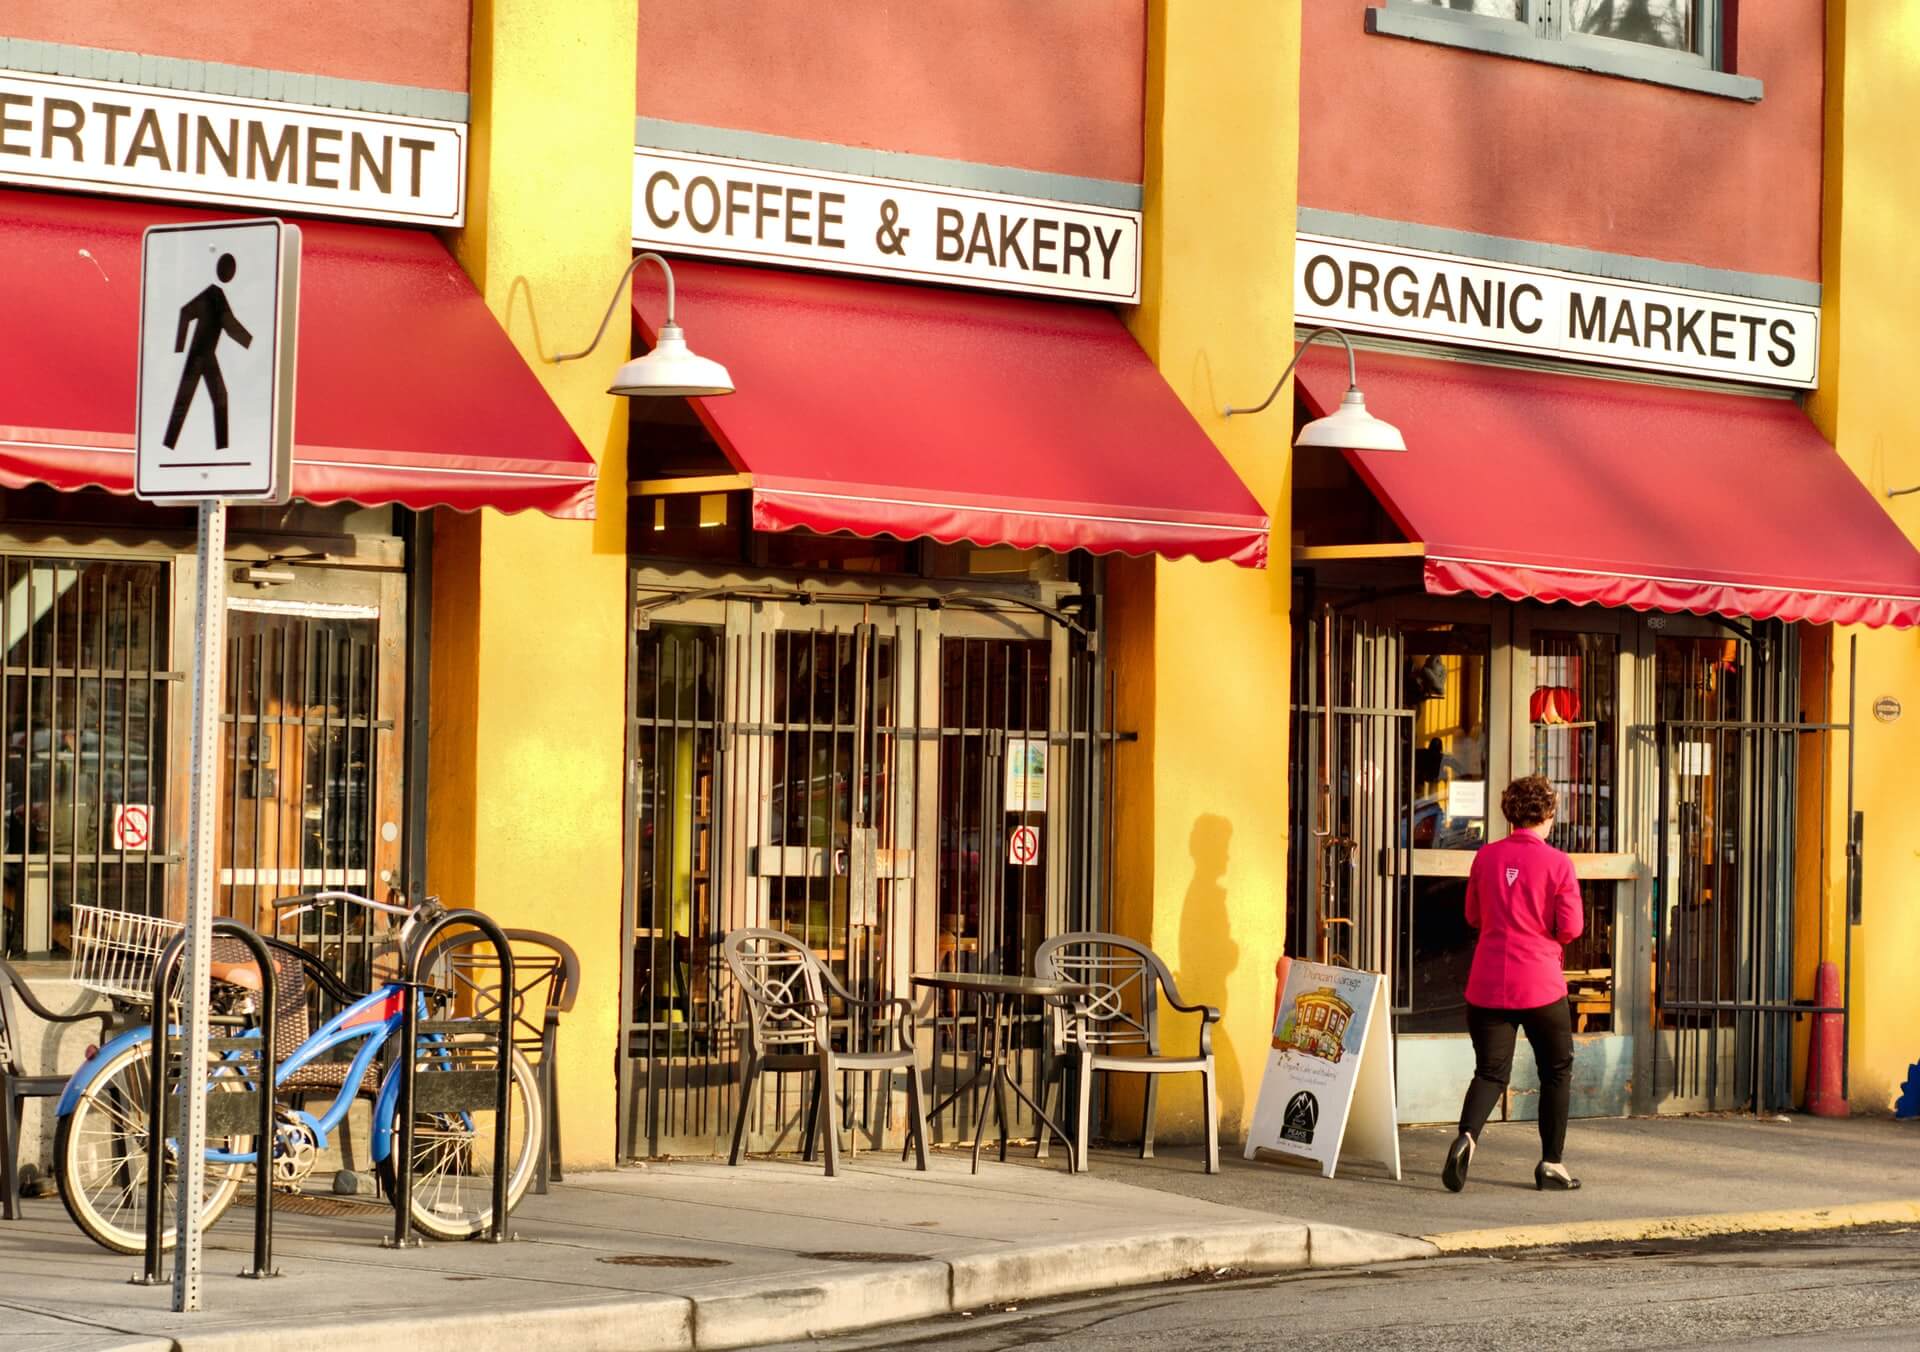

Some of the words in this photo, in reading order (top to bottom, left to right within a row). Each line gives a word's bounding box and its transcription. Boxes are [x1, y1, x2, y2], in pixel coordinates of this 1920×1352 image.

[0, 92, 435, 198] ERTAINMENT
[645, 170, 845, 249] COFFEE
[876, 199, 910, 256] &
[936, 207, 1122, 280] BAKERY
[1304, 254, 1543, 334] ORGANIC
[1569, 293, 1796, 367] MARKETS
[1333, 973, 1362, 992] Garage
